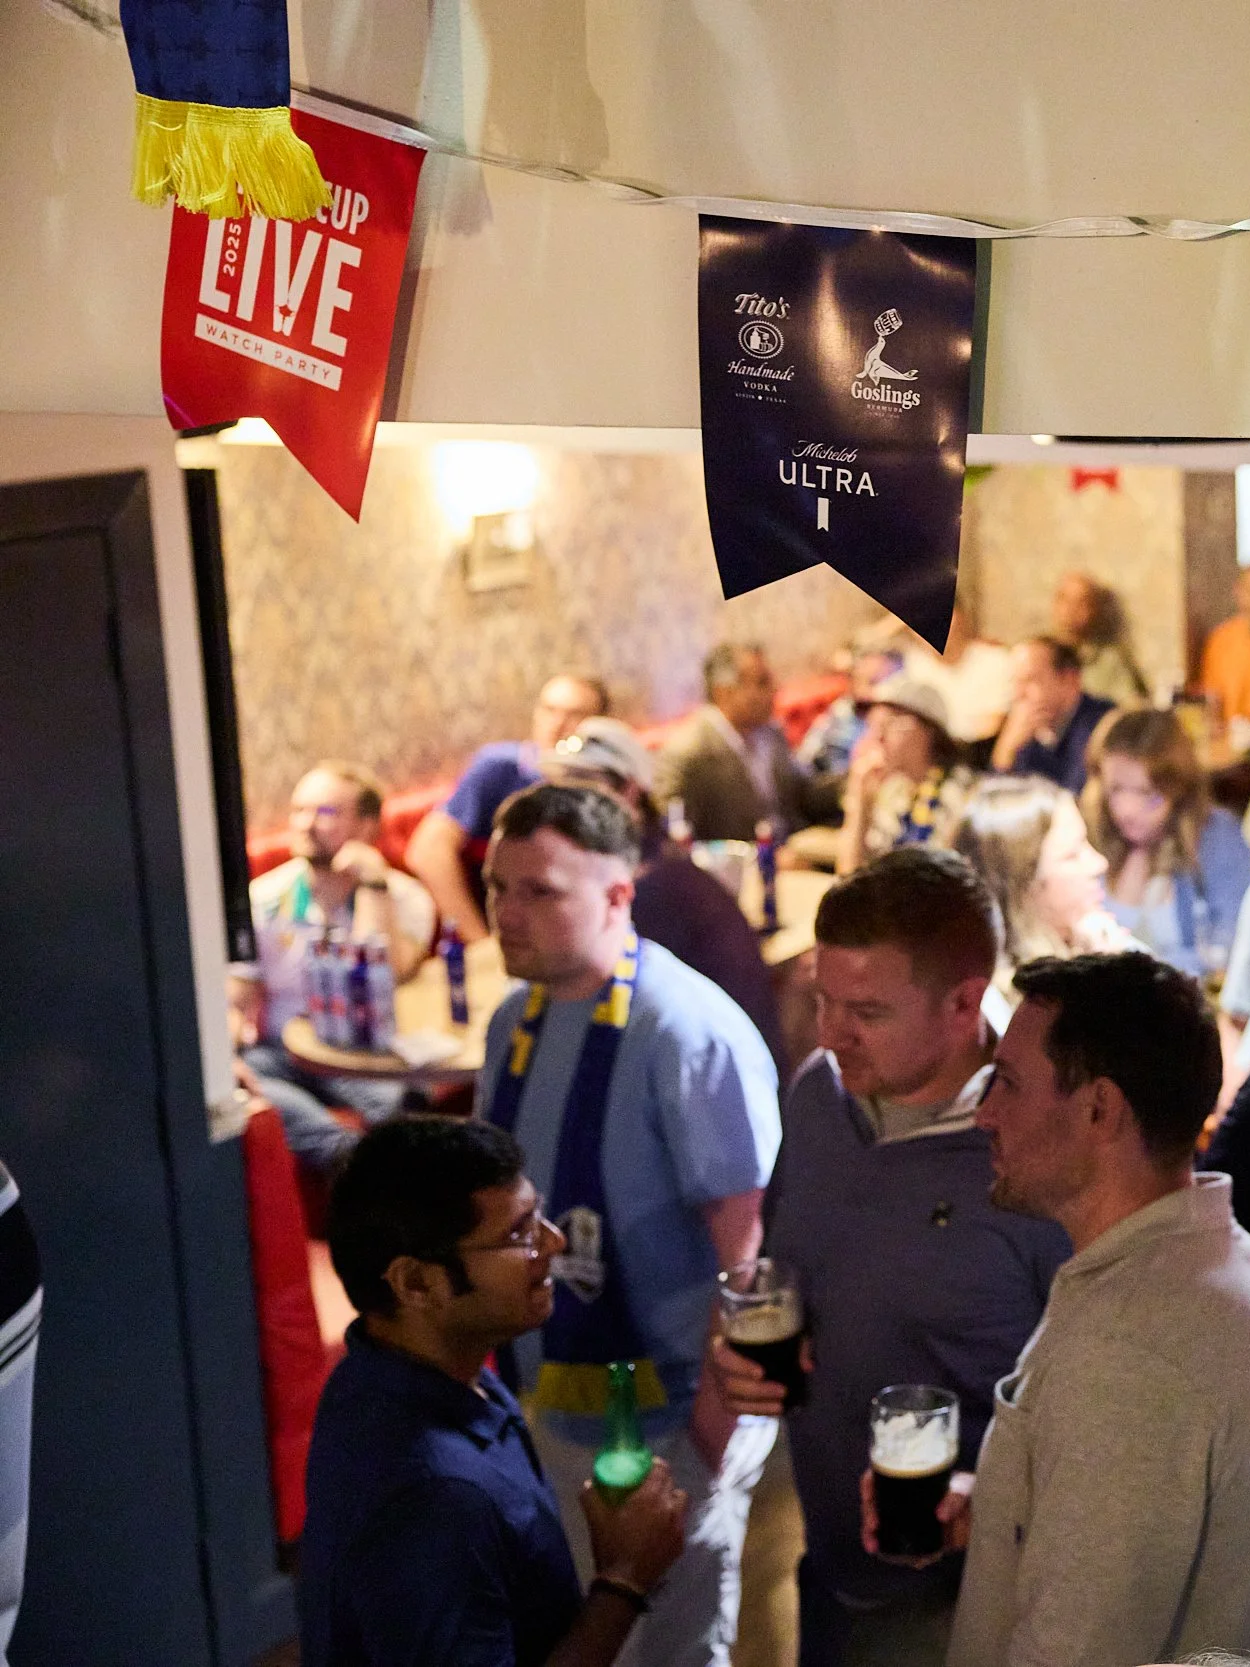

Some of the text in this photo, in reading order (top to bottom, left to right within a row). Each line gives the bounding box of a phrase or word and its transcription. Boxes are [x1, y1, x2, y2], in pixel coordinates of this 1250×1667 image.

[223, 223, 241, 277] 2025
[199, 213, 362, 358] LIVE
[734, 292, 790, 320] Tito's
[206, 323, 331, 380] WATCH PARTY
[728, 359, 795, 381] Handmade
[743, 381, 778, 393] VODKA
[851, 381, 920, 410] Goslings
[791, 440, 859, 463] Michelob
[779, 460, 875, 497] ULTRA
